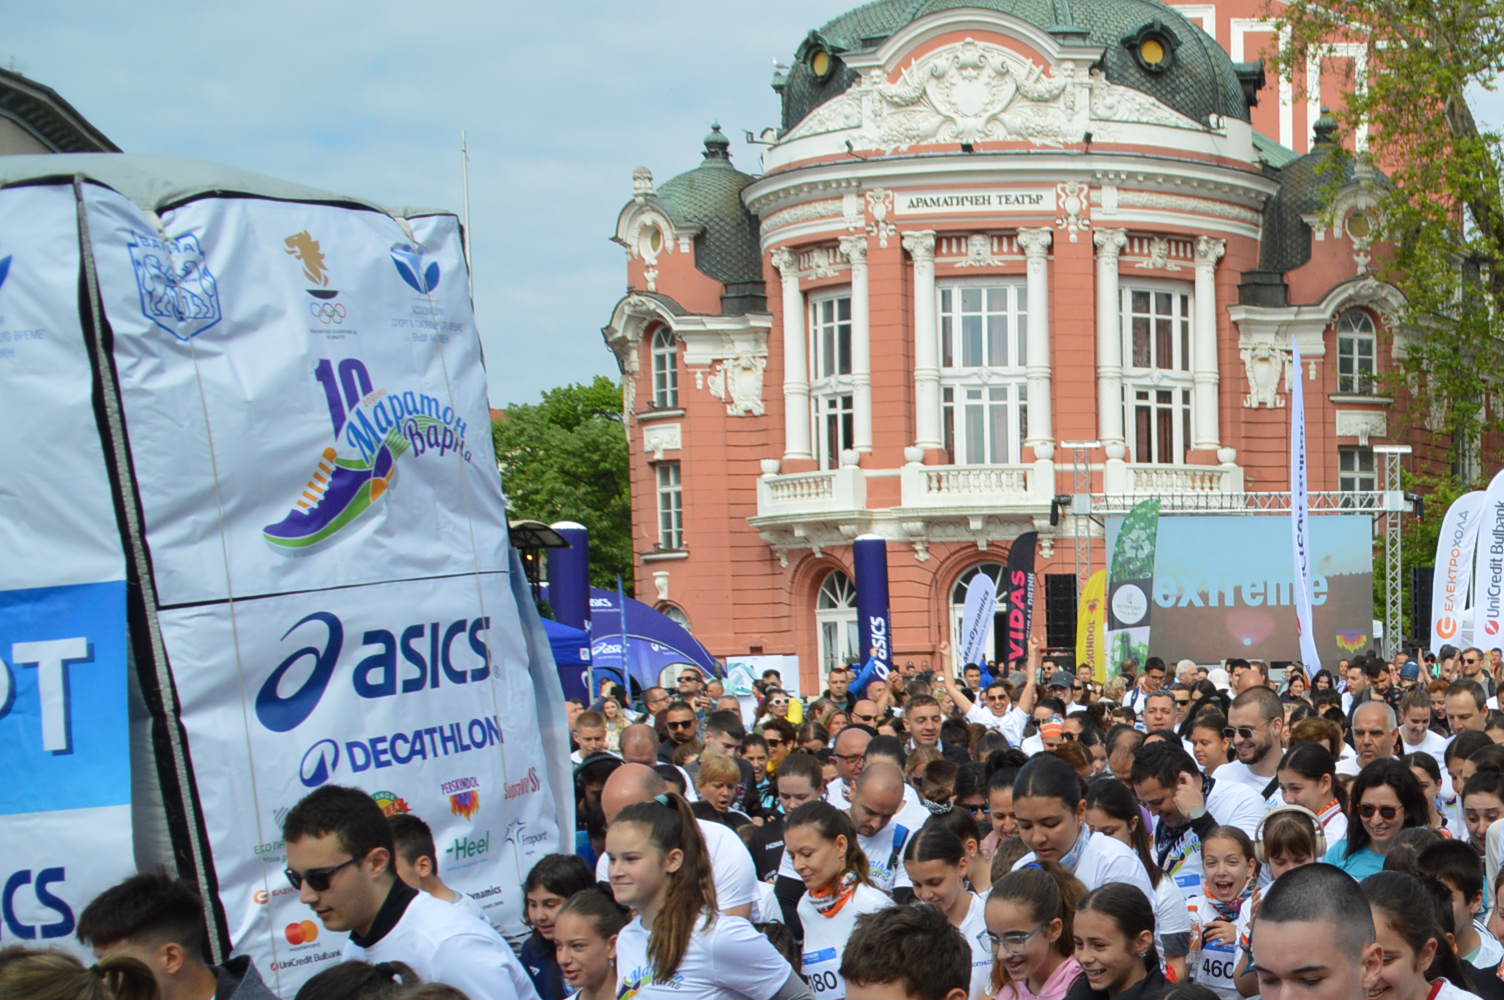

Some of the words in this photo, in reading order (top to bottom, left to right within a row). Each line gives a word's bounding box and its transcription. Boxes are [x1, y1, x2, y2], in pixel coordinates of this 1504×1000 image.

[907, 195, 992, 208] ДРАМАТИЧЕН
[996, 194, 1043, 205] ТЕАТЪР
[347, 391, 467, 464] Маратон
[404, 418, 472, 463] Варна
[1008, 569, 1026, 662] VIDAS
[1487, 557, 1504, 618] UniCredit
[0, 637, 92, 753] Т
[345, 716, 504, 773] DECATHLON
[279, 956, 312, 970] UniCredit
[314, 950, 342, 965] Bulbank
